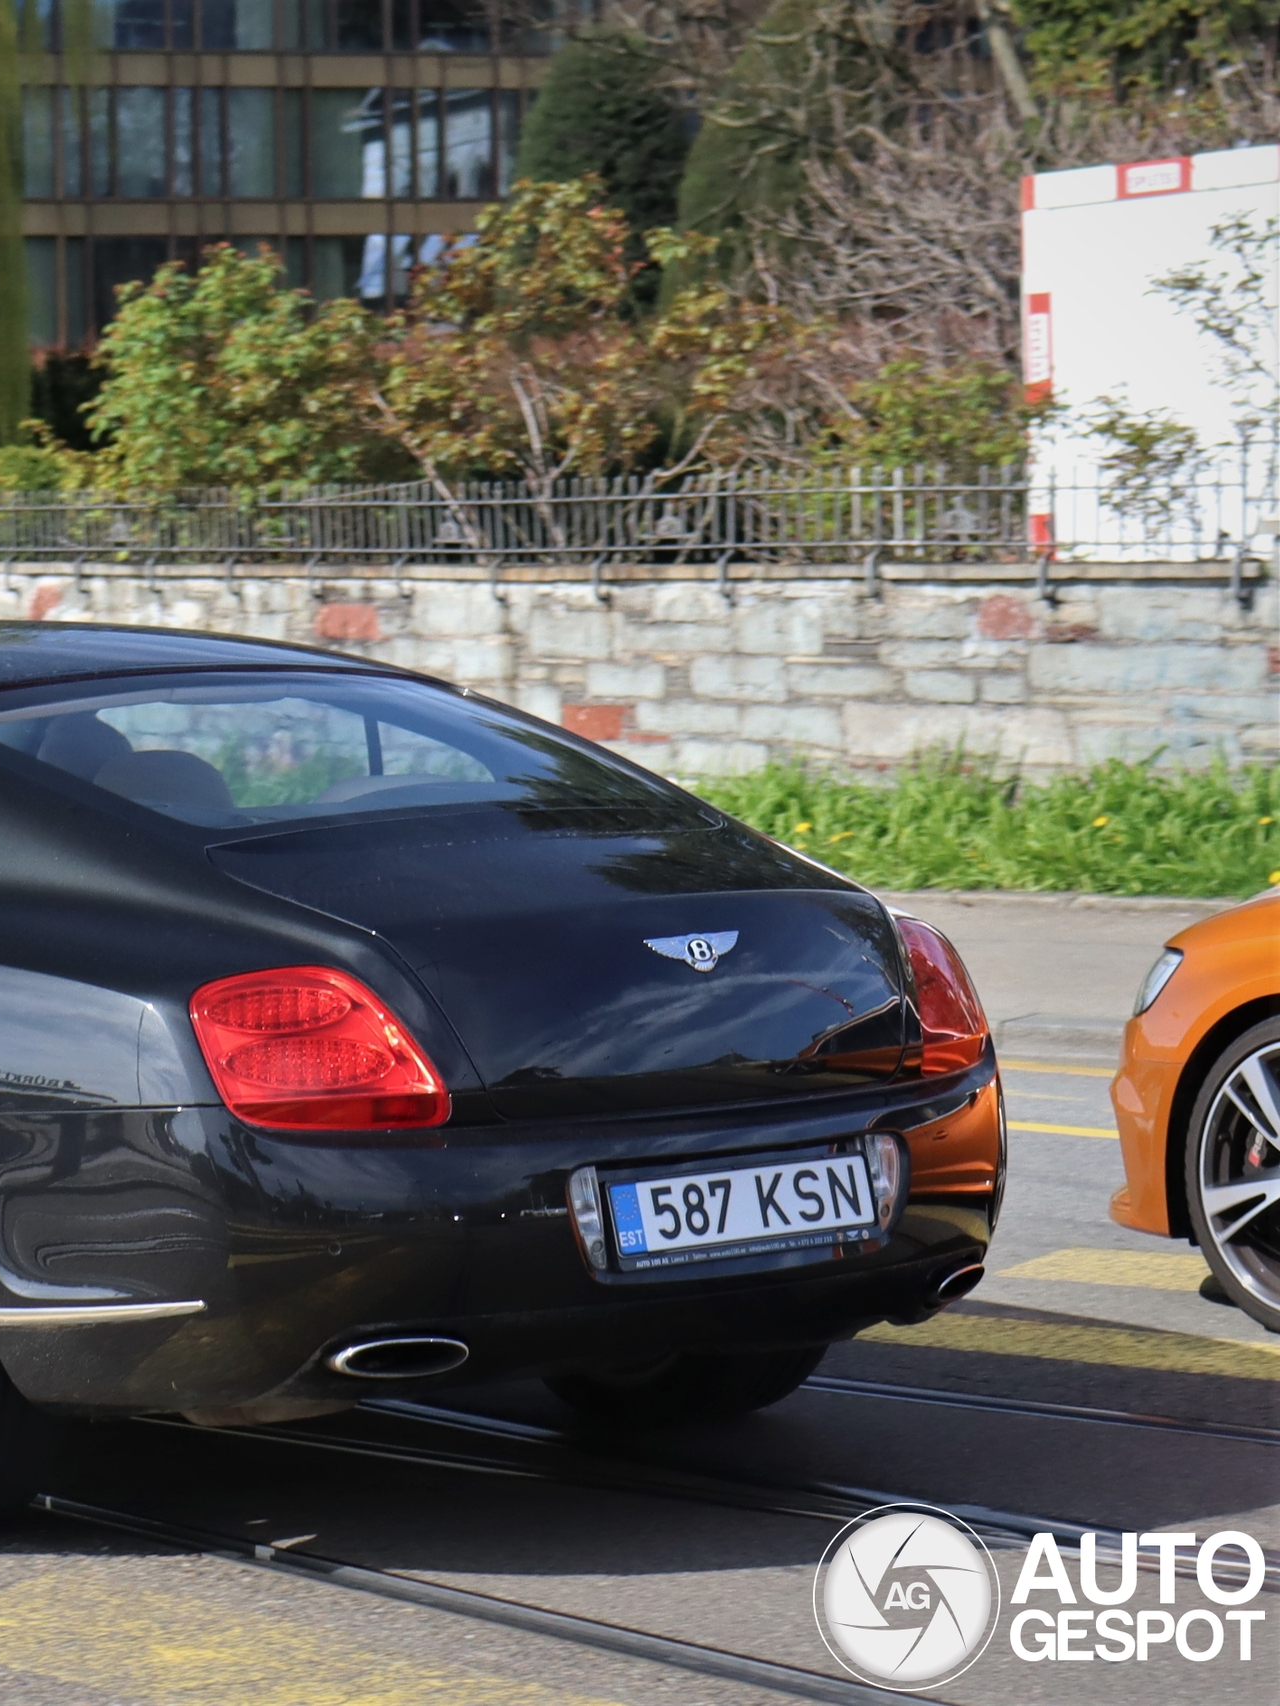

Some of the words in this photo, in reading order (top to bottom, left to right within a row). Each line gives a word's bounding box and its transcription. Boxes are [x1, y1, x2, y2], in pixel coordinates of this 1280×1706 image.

[650, 1179, 732, 1240] 587
[754, 1164, 862, 1228] KSN
[620, 1229, 644, 1248] EST
[635, 1259, 650, 1268] AUTO
[650, 1258, 661, 1266] 100
